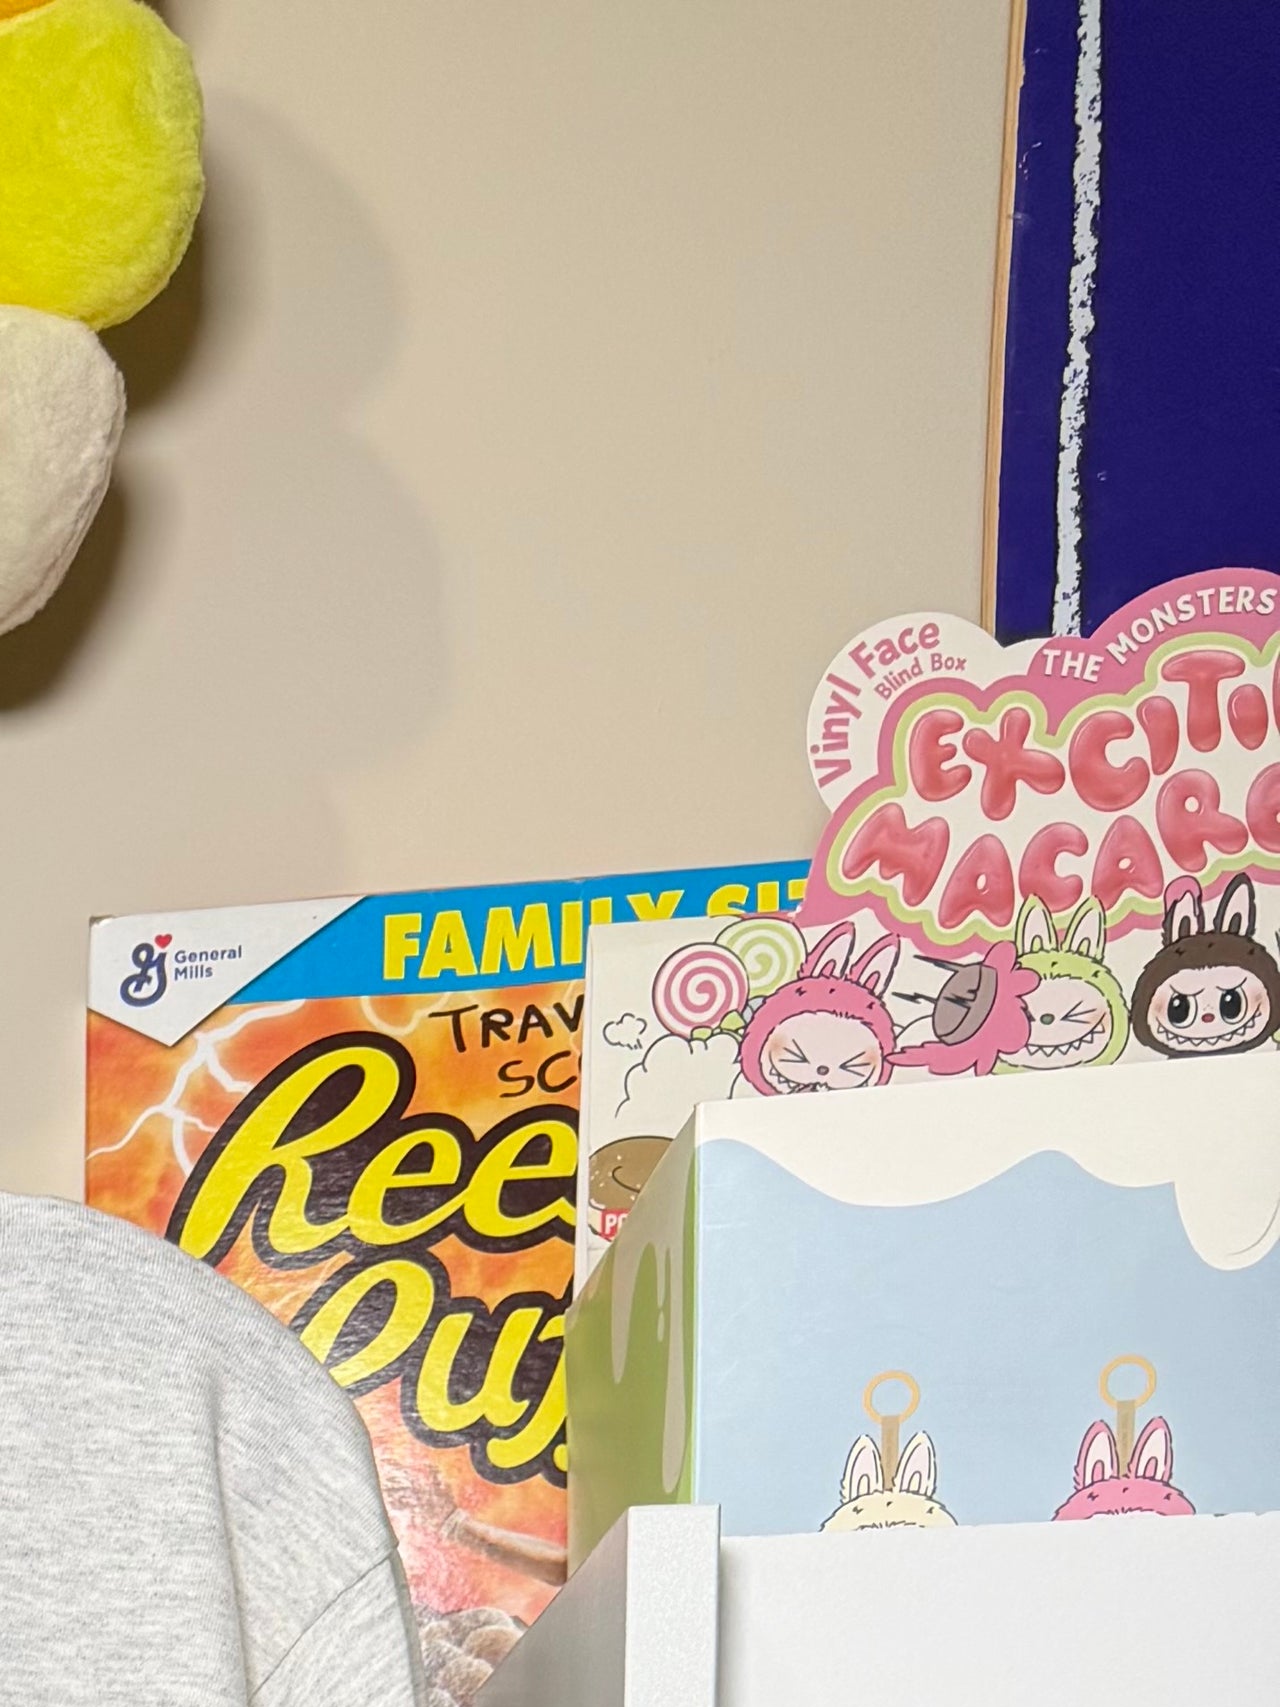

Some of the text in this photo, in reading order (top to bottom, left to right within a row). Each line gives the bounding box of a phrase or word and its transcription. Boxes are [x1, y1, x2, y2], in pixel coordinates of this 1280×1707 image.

[1041, 586, 1276, 684] THE MONSTERS
[811, 621, 940, 788] Vinyl Face
[874, 653, 967, 700] Blind Box
[908, 645, 1280, 820] EXCITI
[174, 945, 242, 964] General
[174, 965, 213, 981] Mills
